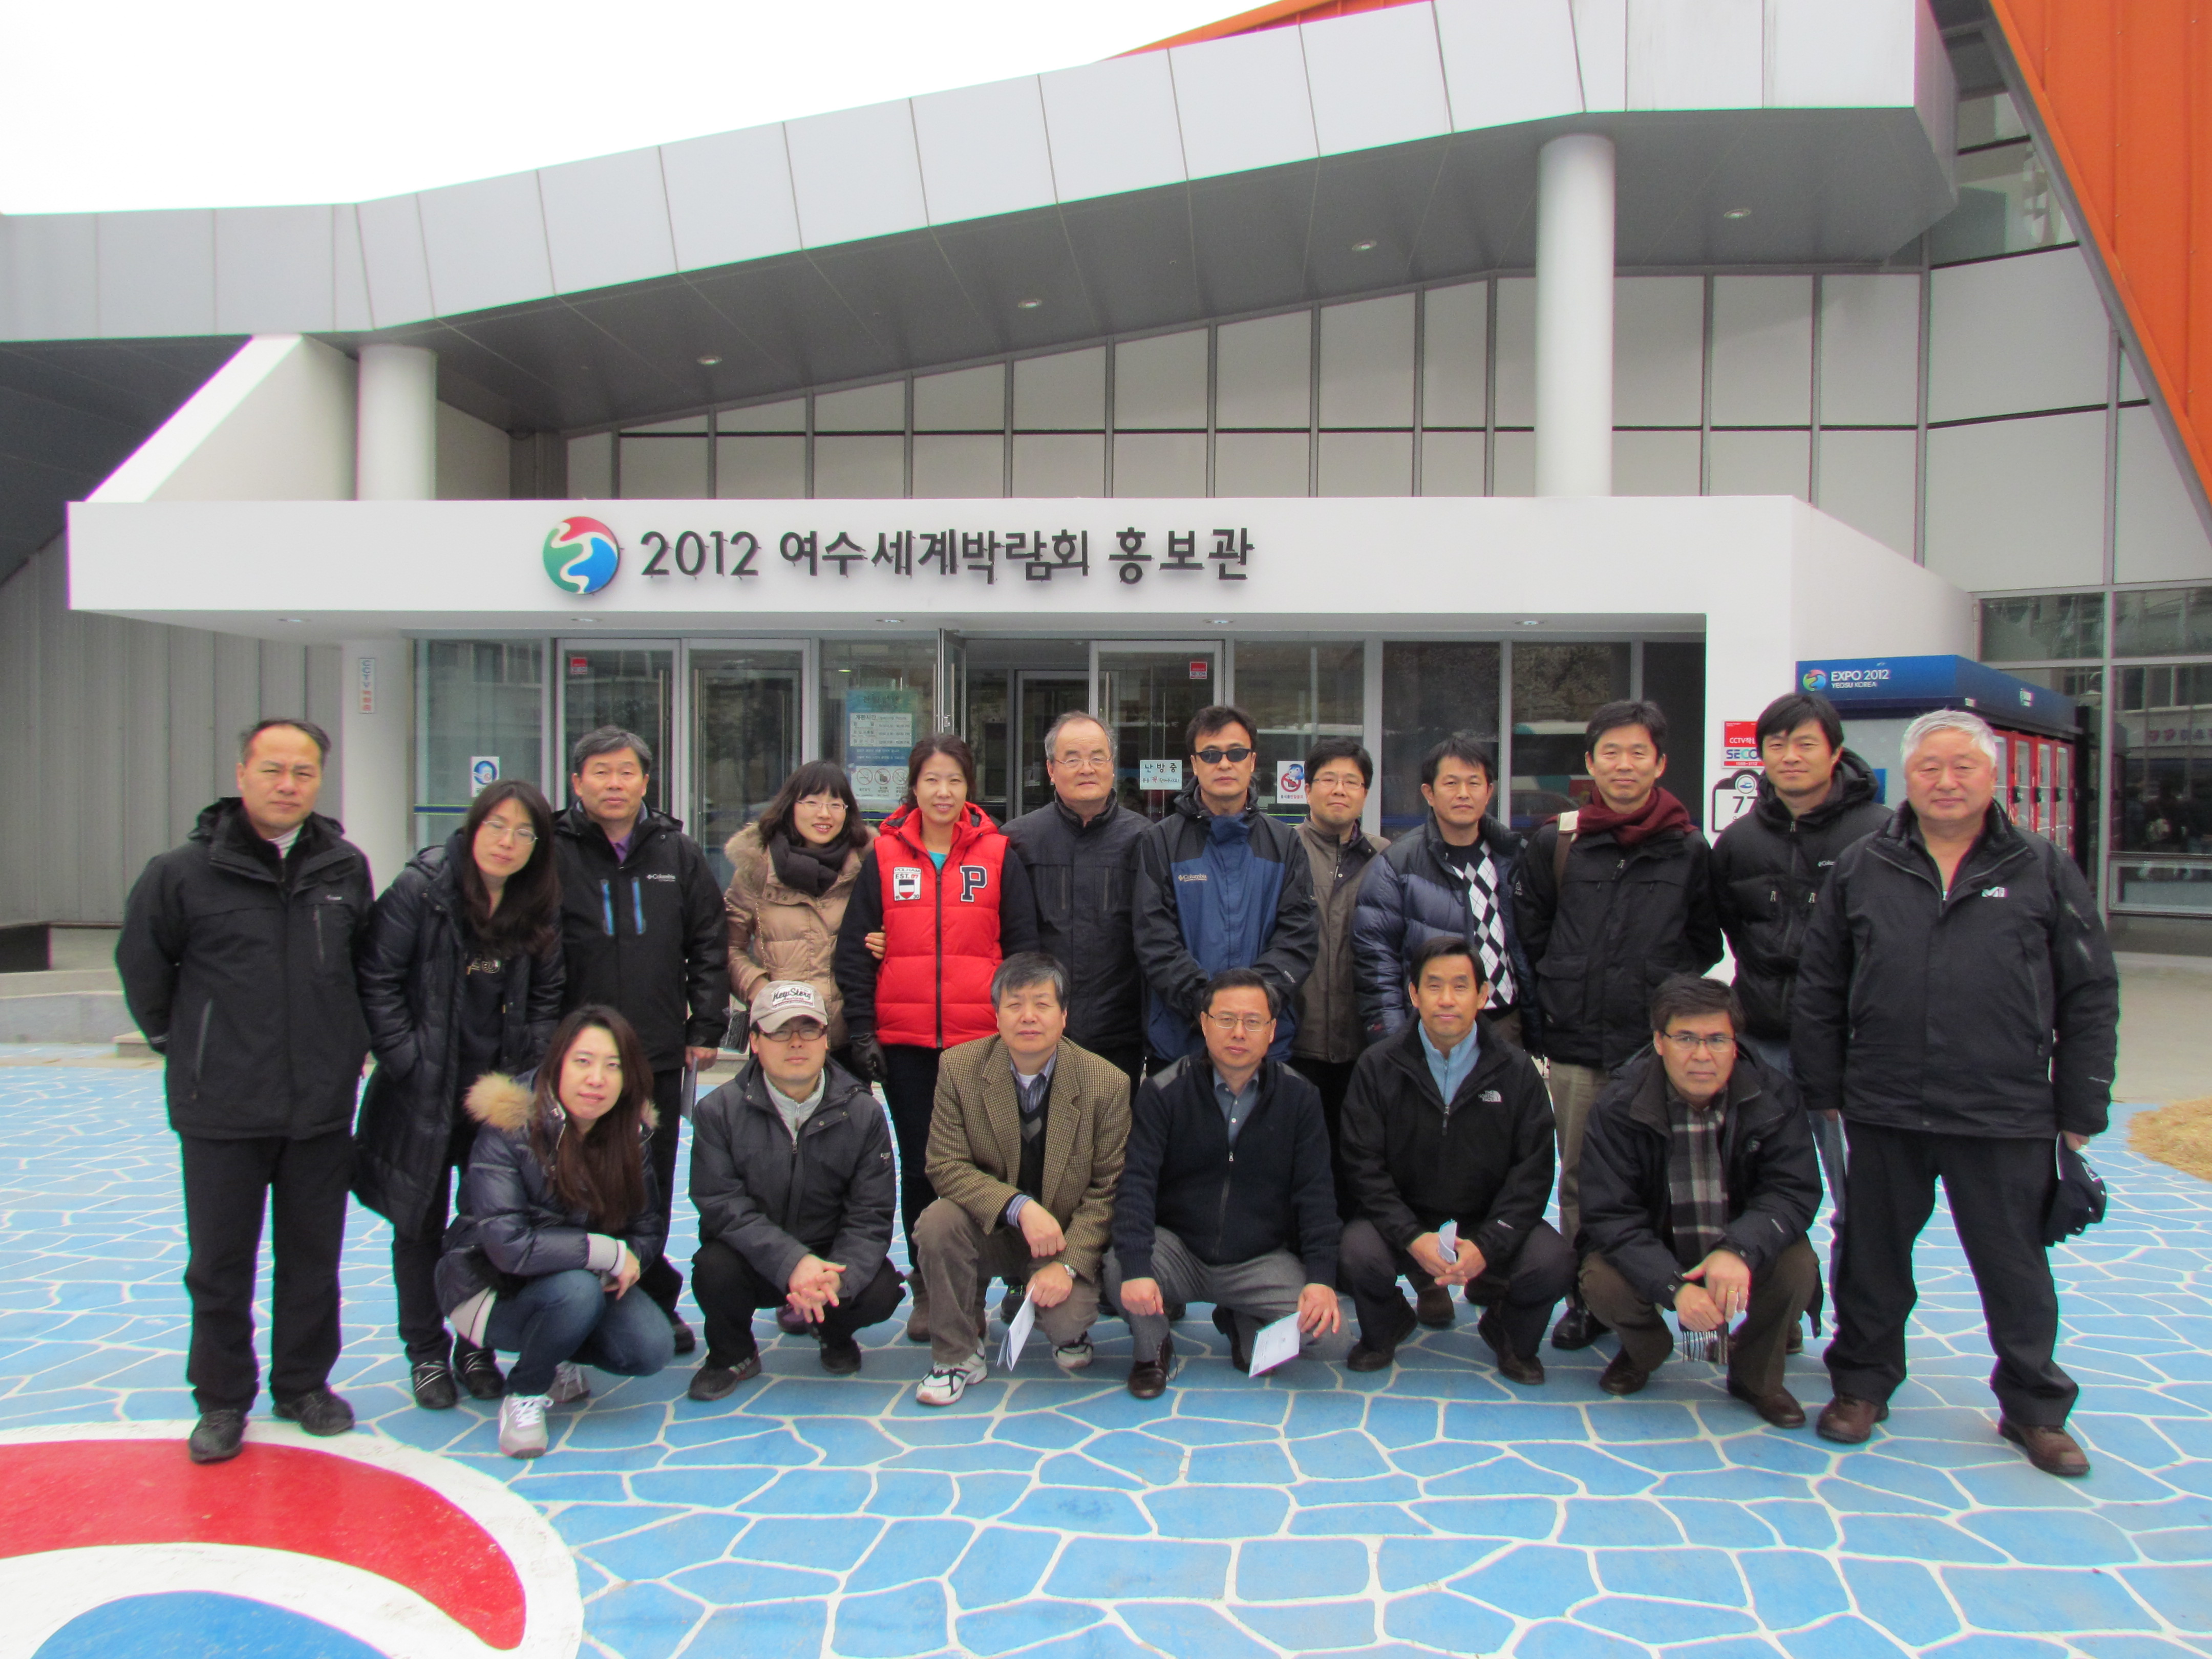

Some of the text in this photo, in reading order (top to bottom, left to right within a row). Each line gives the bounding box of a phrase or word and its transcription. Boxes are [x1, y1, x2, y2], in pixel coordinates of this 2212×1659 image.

[640, 527, 1253, 585] 2012 여수세계박람회 홍보관
[1831, 669, 1889, 682] EXPO 2012
[1726, 749, 1758, 759] SECO
[960, 865, 987, 902] P
